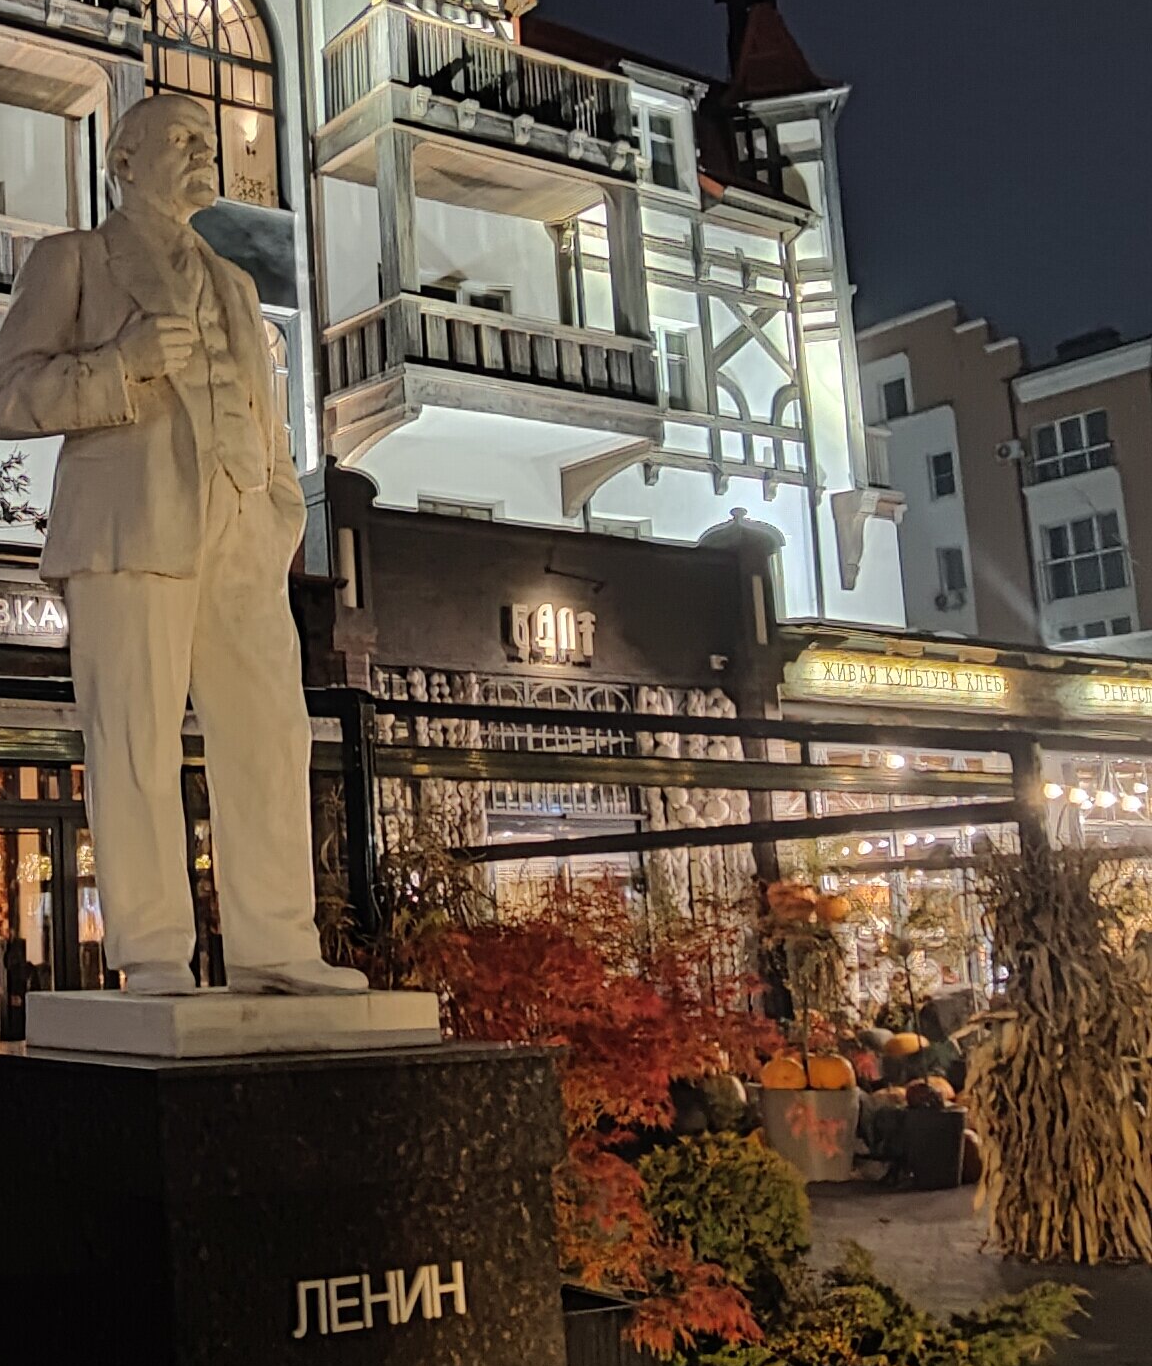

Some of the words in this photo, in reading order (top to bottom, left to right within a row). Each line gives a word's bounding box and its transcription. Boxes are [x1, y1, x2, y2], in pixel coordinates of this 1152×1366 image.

[822, 660, 878, 685] ЖИВАЯ
[884, 665, 959, 690] КУЛЬТУРА
[292, 1260, 467, 1339] ЛЕНИН
